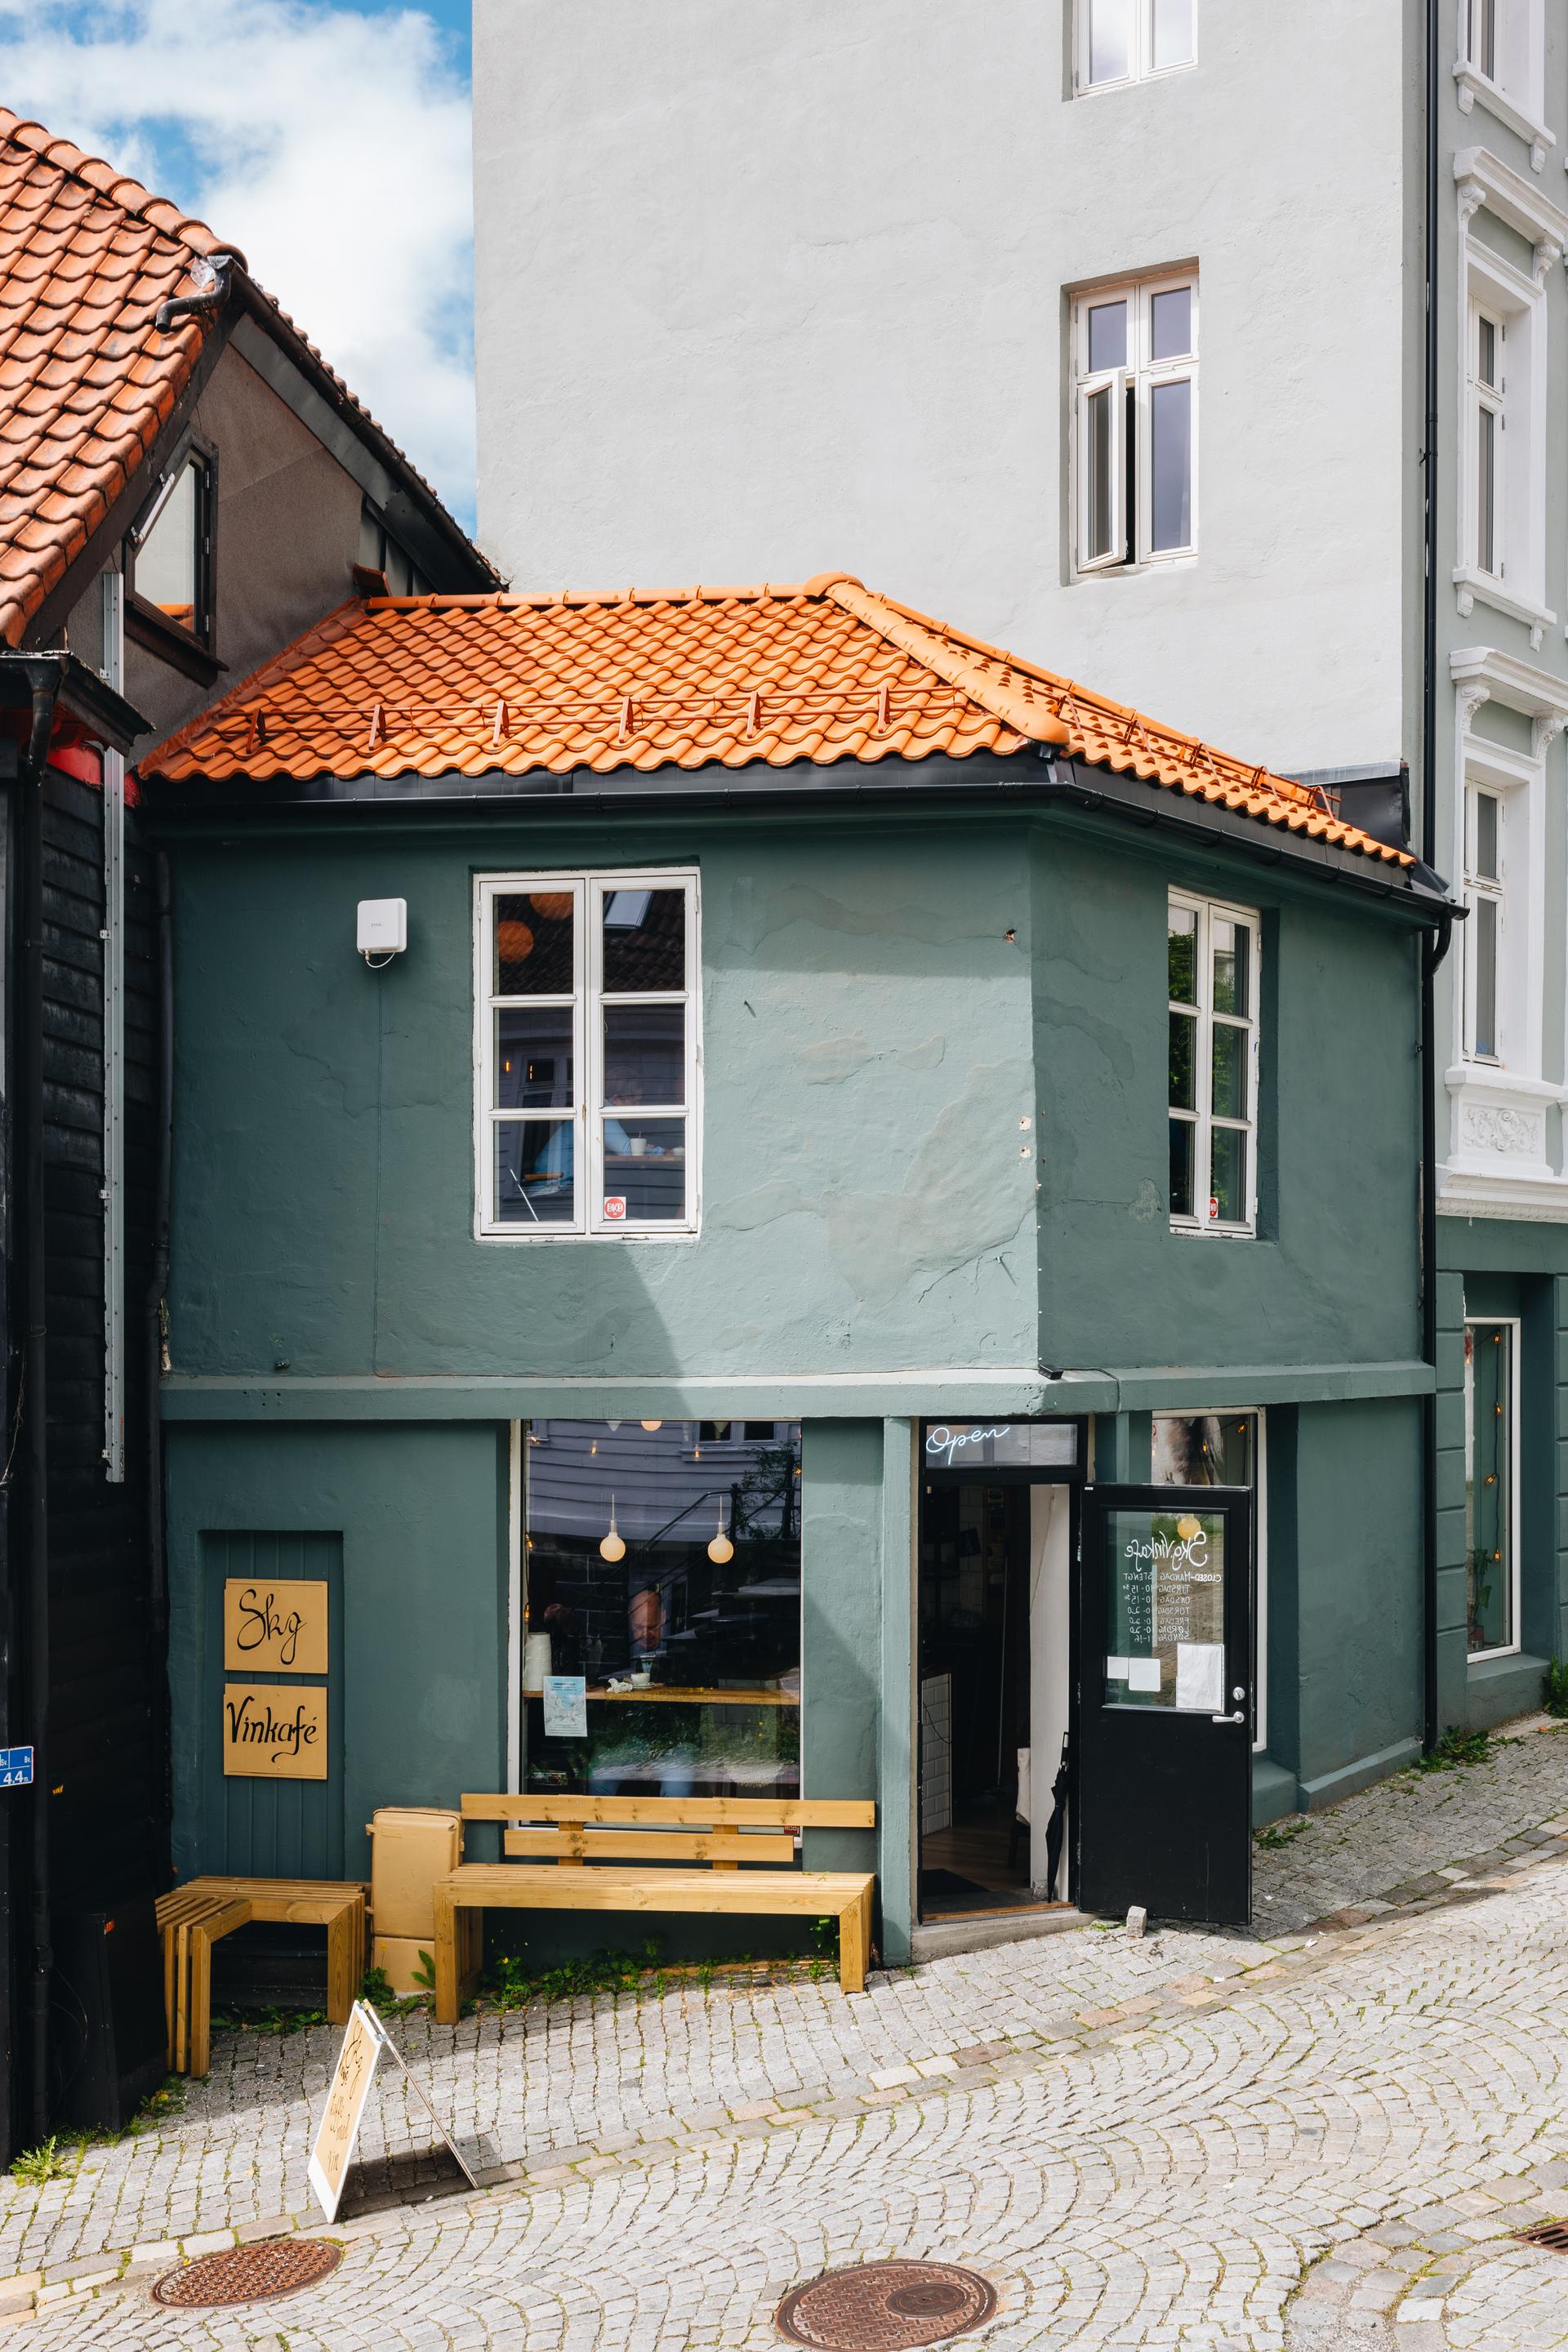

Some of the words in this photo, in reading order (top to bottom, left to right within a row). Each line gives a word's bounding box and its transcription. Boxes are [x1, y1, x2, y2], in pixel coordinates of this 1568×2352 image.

[925, 1426, 1010, 1466] Open
[236, 1588, 307, 1665] Skg
[225, 1695, 318, 1764] Vinkafé
